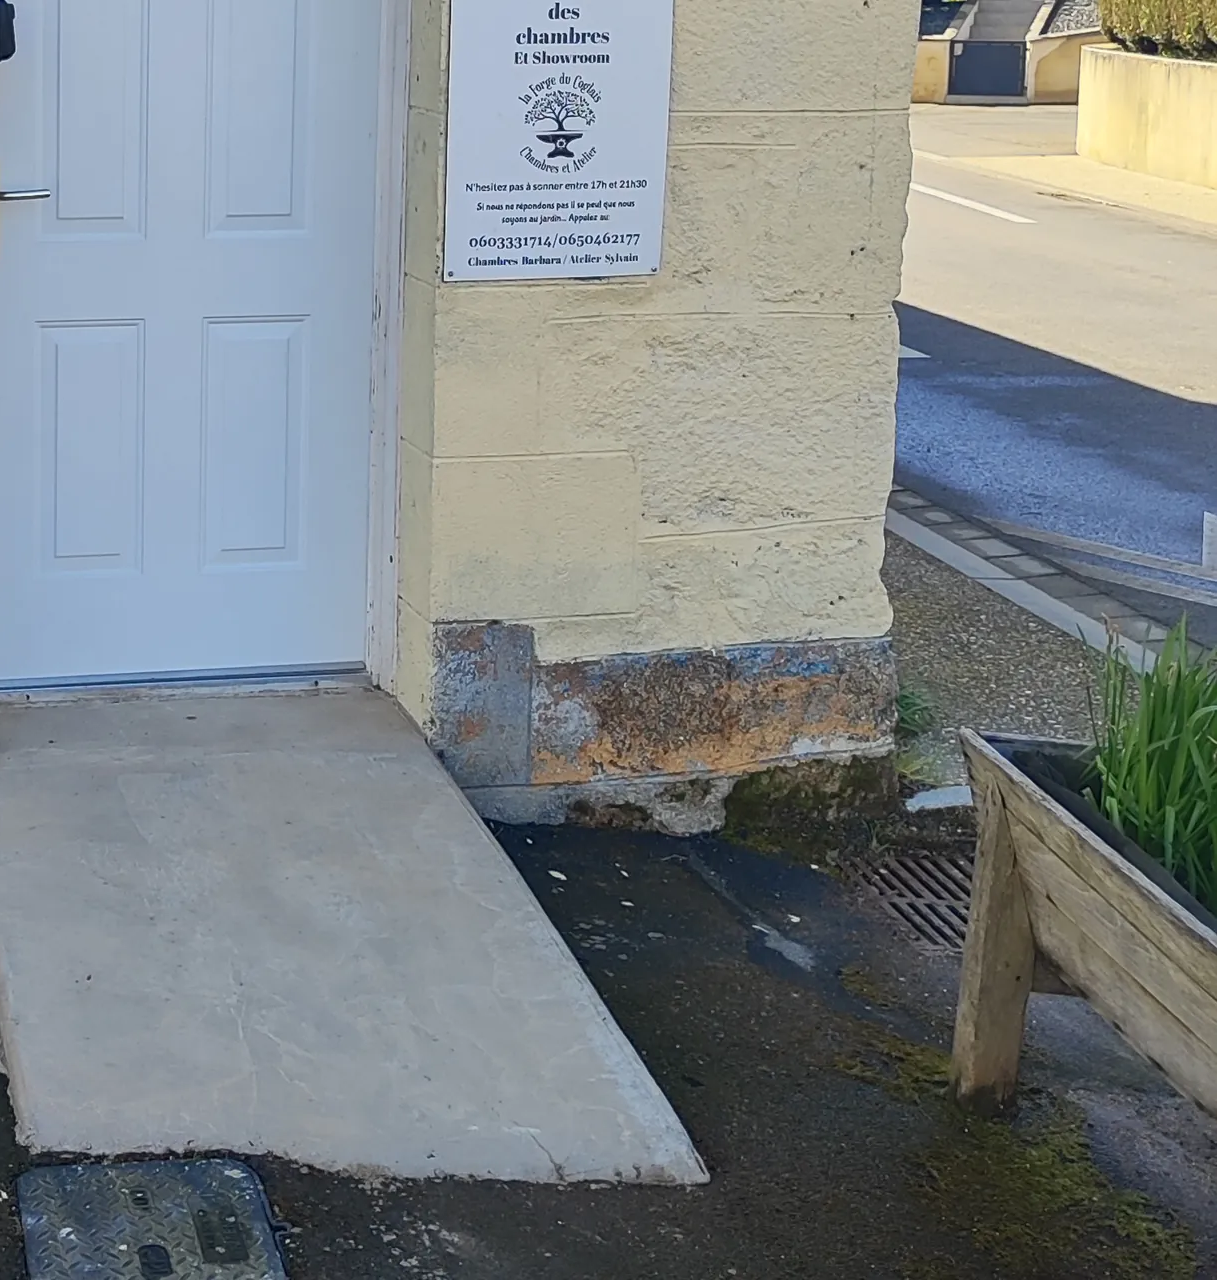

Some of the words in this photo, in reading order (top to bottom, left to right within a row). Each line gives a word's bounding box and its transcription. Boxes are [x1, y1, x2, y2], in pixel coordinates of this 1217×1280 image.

[548, 2, 580, 20] des
[516, 27, 610, 45] chambres
[514, 51, 528, 64] Et
[532, 50, 610, 64] Showroom
[518, 93, 532, 105] la
[529, 76, 556, 97] Forge
[559, 72, 571, 84] du
[572, 75, 601, 103] Coglais
[519, 146, 559, 173] Chambres
[561, 163, 571, 173] et
[572, 147, 597, 172] Atelier
[509, 183, 524, 193] pas
[525, 182, 531, 191] à
[532, 183, 563, 191] sonner
[565, 181, 589, 189] entre
[591, 180, 607, 189] 17h
[608, 181, 617, 189] et
[619, 179, 647, 188] 21h30
[476, 202, 485, 211] Si
[515, 201, 554, 212] répondons
[556, 202, 569, 211] pas
[586, 200, 602, 210] peut
[603, 201, 616, 210] que
[502, 216, 527, 226] soyons
[568, 213, 598, 224] Appelez
[469, 232, 640, 250] 0603331714/0650462177
[467, 256, 518, 266] Chambres
[521, 255, 561, 265] Barbara
[569, 253, 602, 264] Atelier
[605, 253, 638, 265] Sylvain
